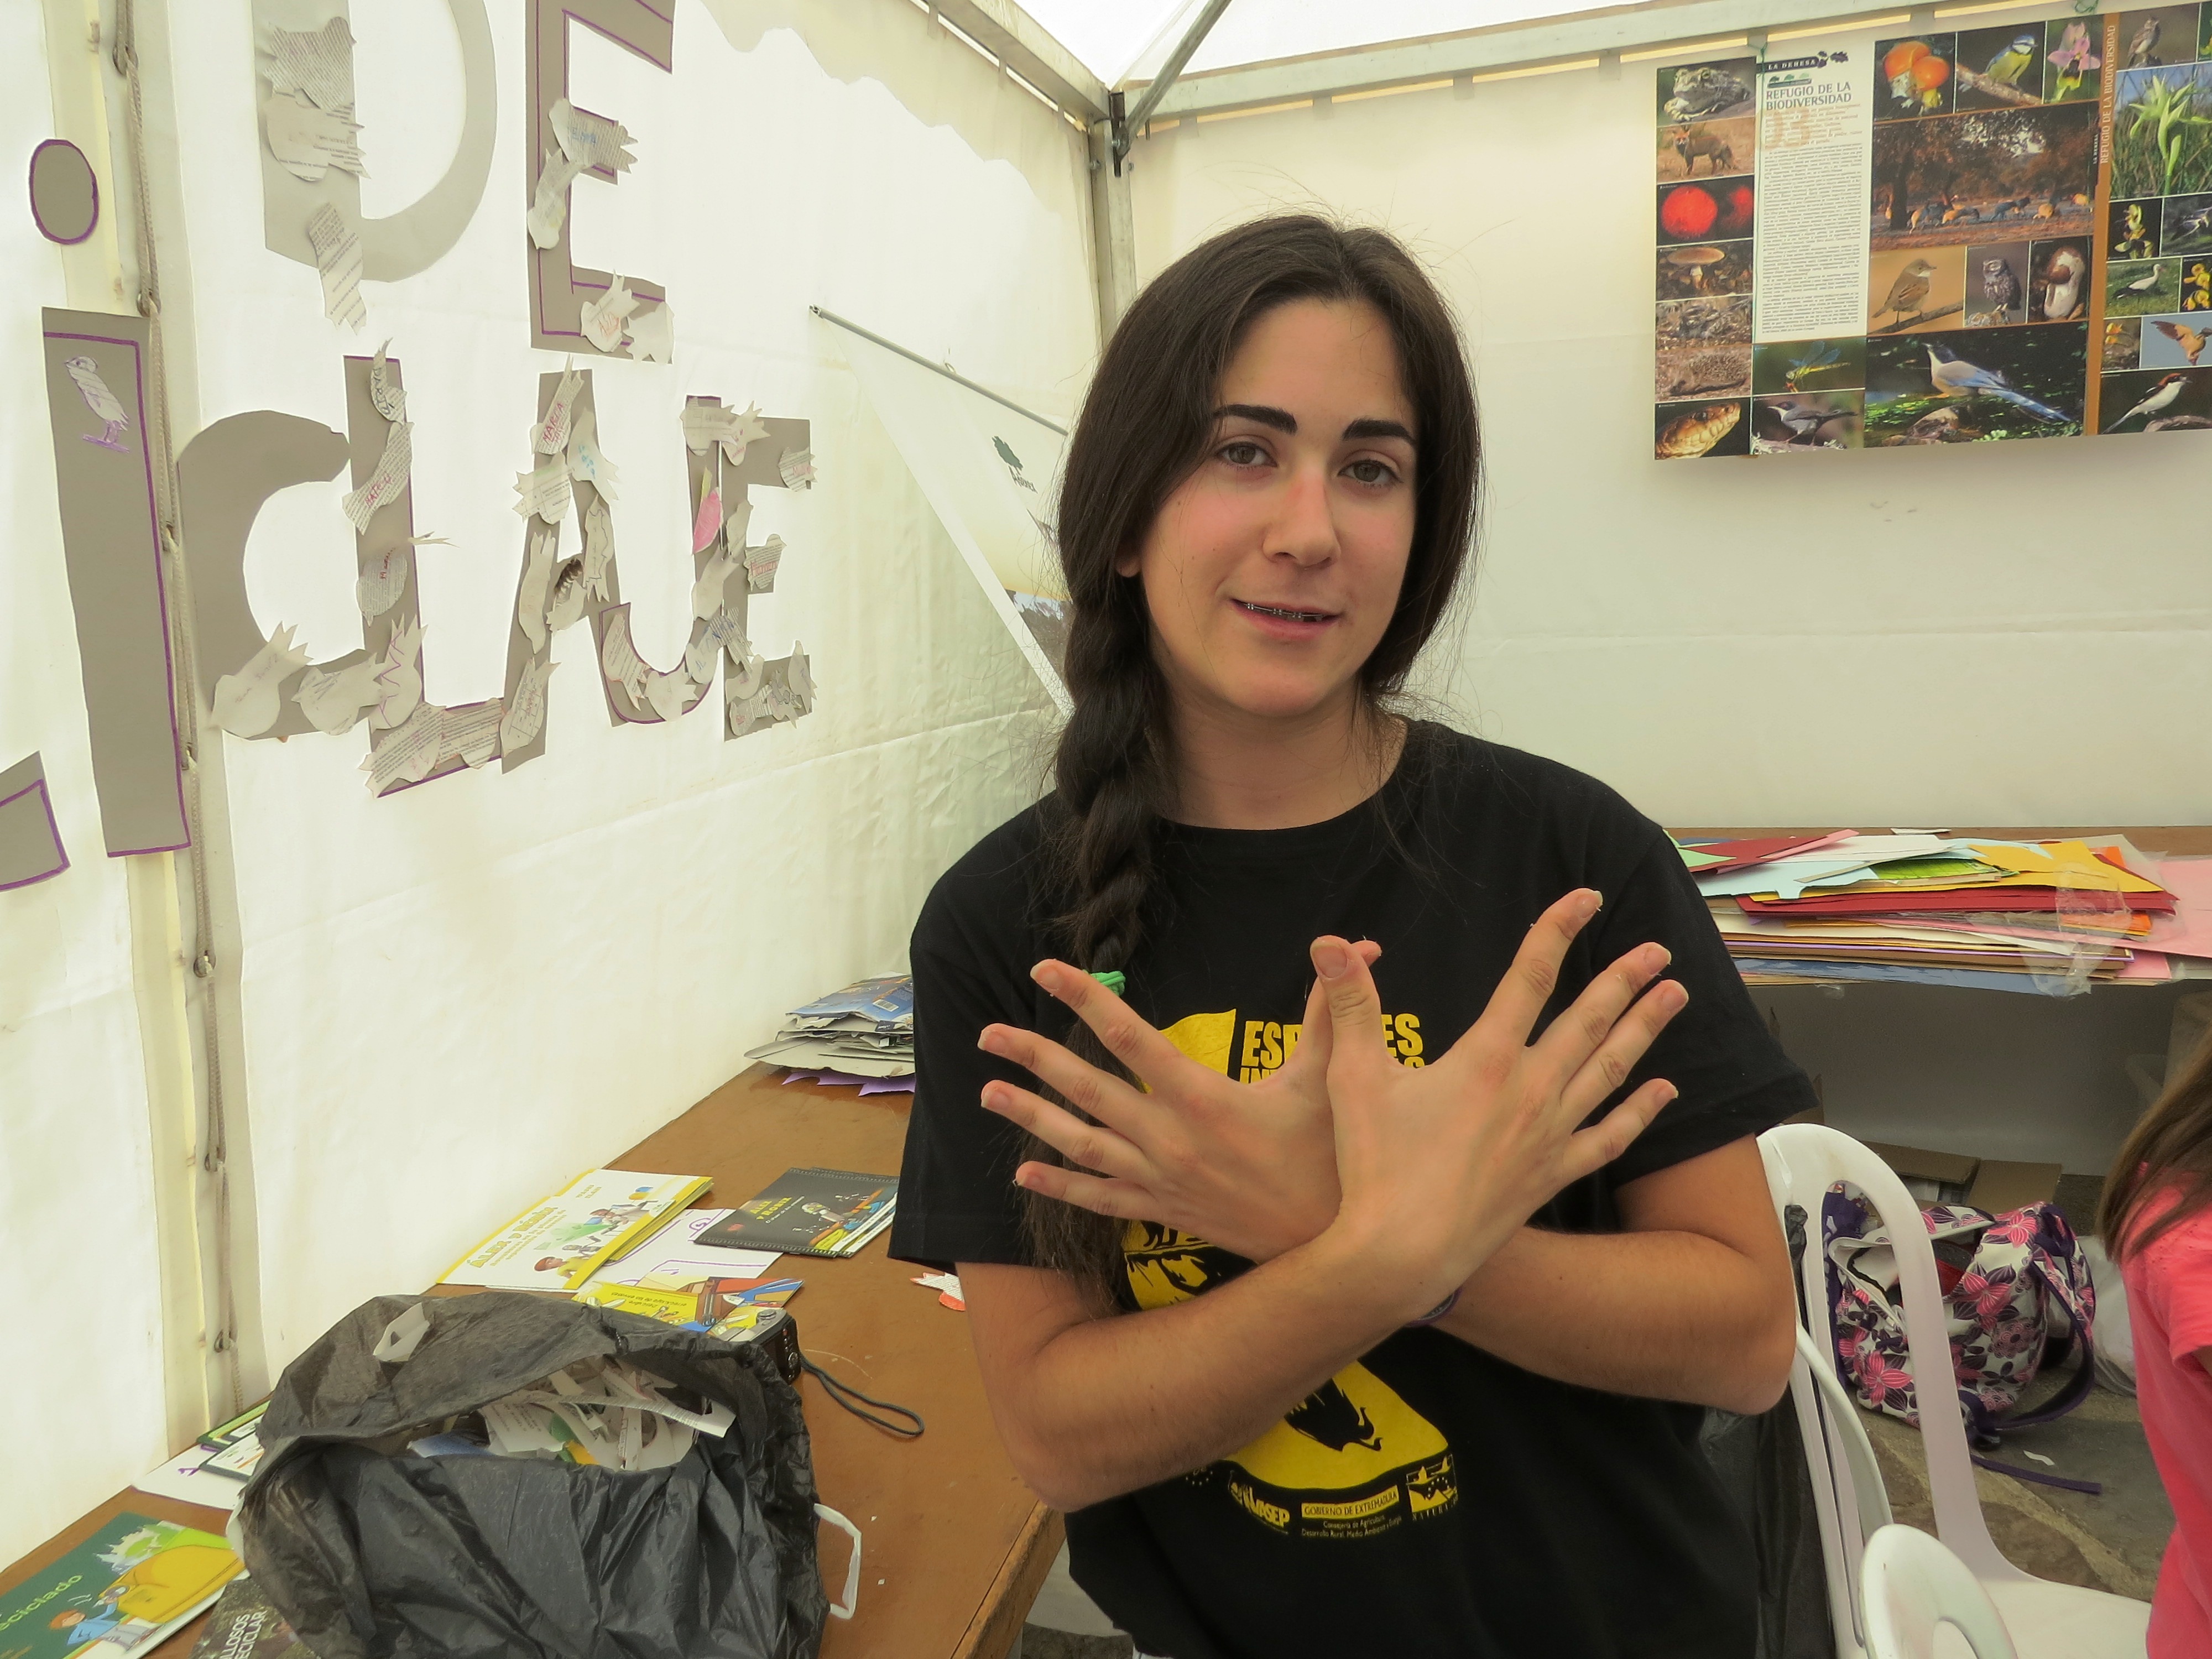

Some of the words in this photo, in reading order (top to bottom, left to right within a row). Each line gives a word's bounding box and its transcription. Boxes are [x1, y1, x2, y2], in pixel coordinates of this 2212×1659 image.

[1782, 60, 1816, 69] DEHESA
[2104, 25, 2116, 96] BIODIVERSIDAD
[1766, 86, 1814, 100] REFUGIO
[1818, 84, 1833, 93] DE
[1837, 81, 1851, 92] LA
[1766, 92, 1852, 111] BIODIVERSIDAD
[2103, 97, 2112, 109] LA
[2103, 111, 2111, 124] DE
[2100, 126, 2111, 164] REFUGIO
[1241, 1013, 1424, 1068] ESPES
[628, 1300, 659, 1308] Descubre
[1304, 1505, 1342, 1516] GOBIERNO
[1344, 1505, 1353, 1515] DE
[1355, 1490, 1397, 1514] EXTREMADURA
